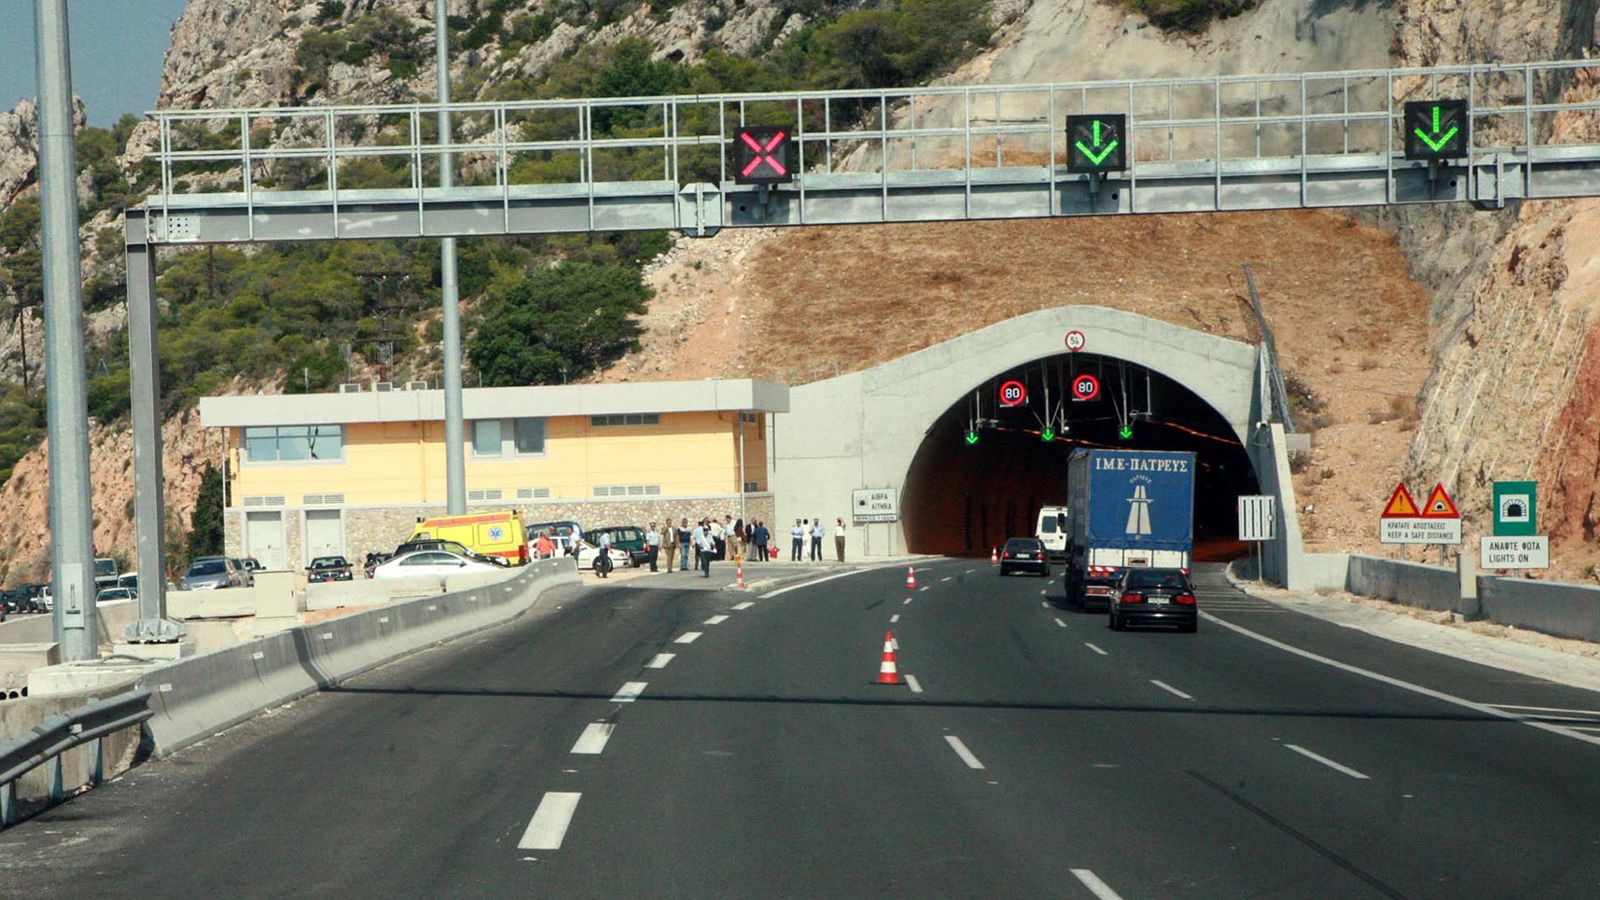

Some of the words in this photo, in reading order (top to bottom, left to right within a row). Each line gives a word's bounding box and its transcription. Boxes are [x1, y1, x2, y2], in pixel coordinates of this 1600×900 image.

[1078, 382, 1093, 393] 80
[1005, 388, 1020, 399] 80
[1387, 531, 1402, 539] KEEP
[1411, 532, 1425, 540] SAFE
[1427, 532, 1454, 540] DISTANCE
[1489, 541, 1519, 551] ΑΝΑΨΤΕ
[1521, 541, 1541, 551] ΦΩΤΑ
[1489, 554, 1515, 563] LIGHTS
[1518, 554, 1529, 563] ON
